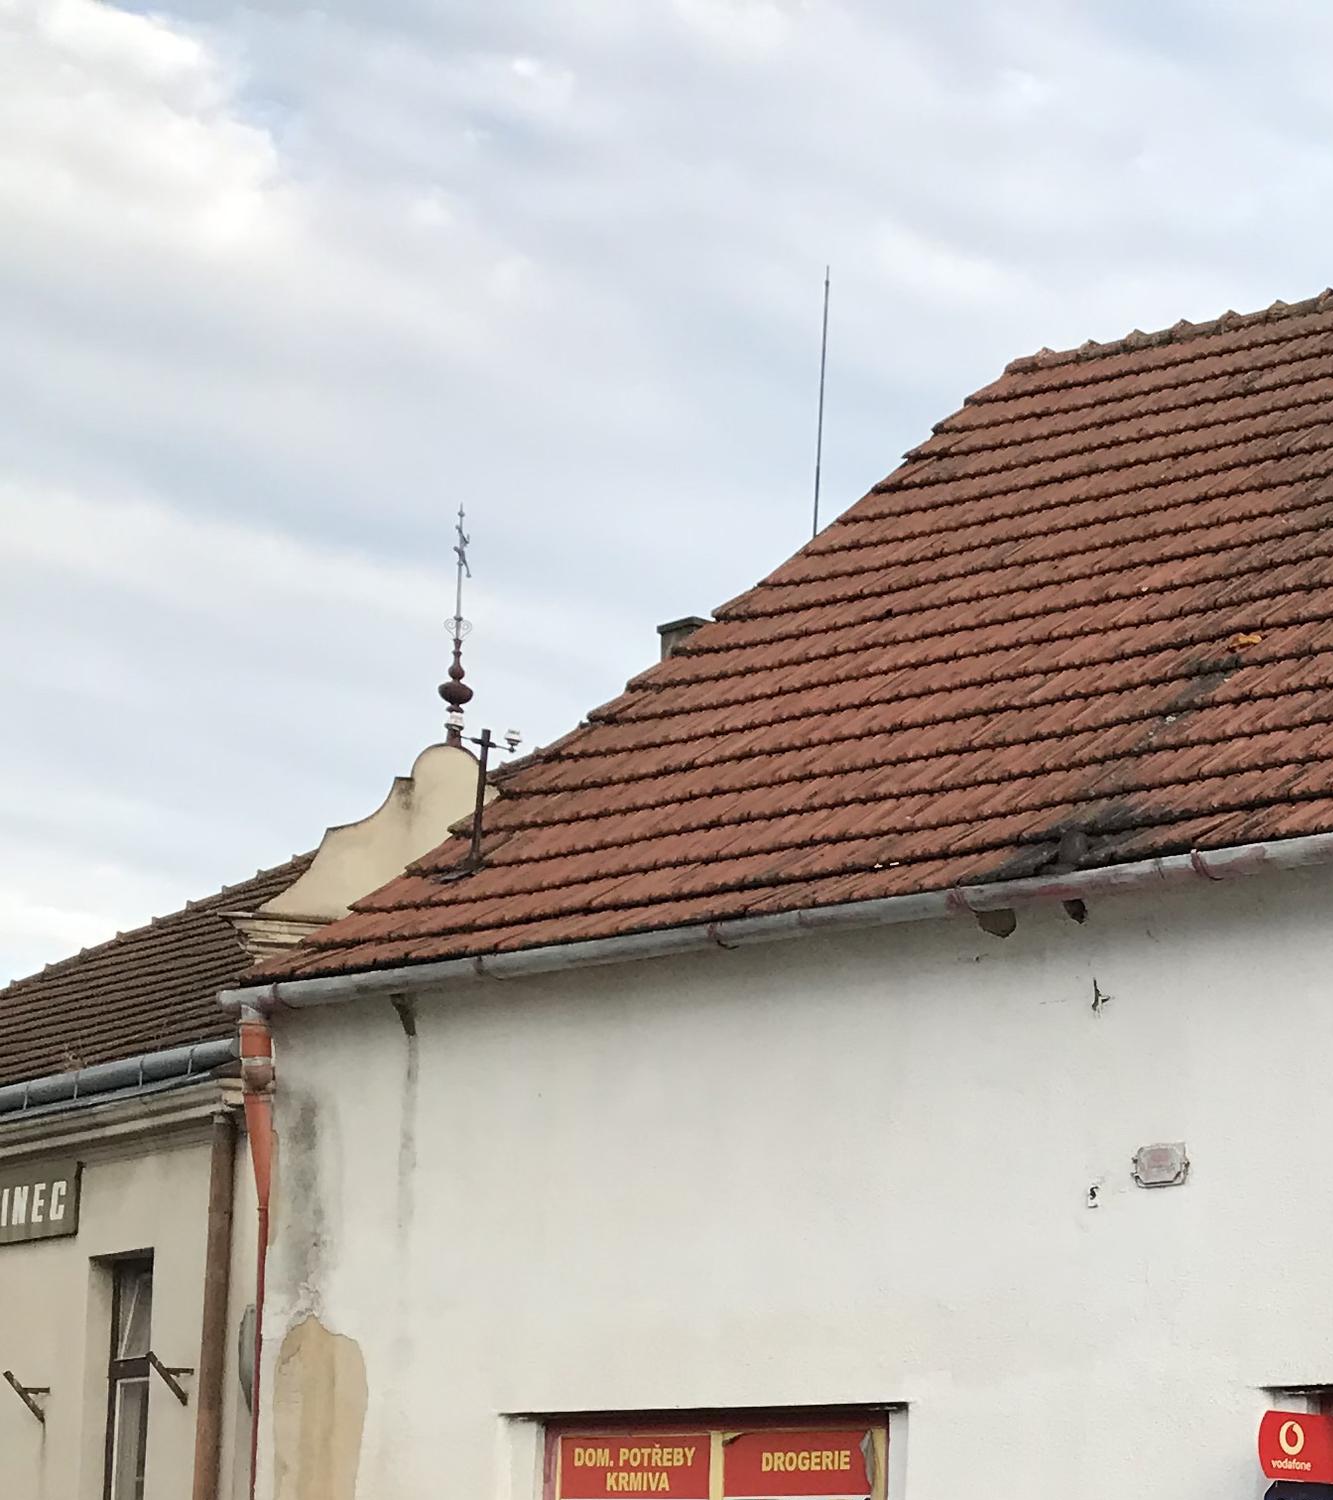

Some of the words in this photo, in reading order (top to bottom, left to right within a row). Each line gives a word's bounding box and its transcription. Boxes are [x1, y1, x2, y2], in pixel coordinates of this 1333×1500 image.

[574, 1447, 614, 1467] DOM.
[619, 1443, 696, 1467] POTŘEBY
[761, 1450, 851, 1472] DROGERIE
[1271, 1458, 1311, 1471] vodafone
[606, 1471, 670, 1491] KRMIVA
